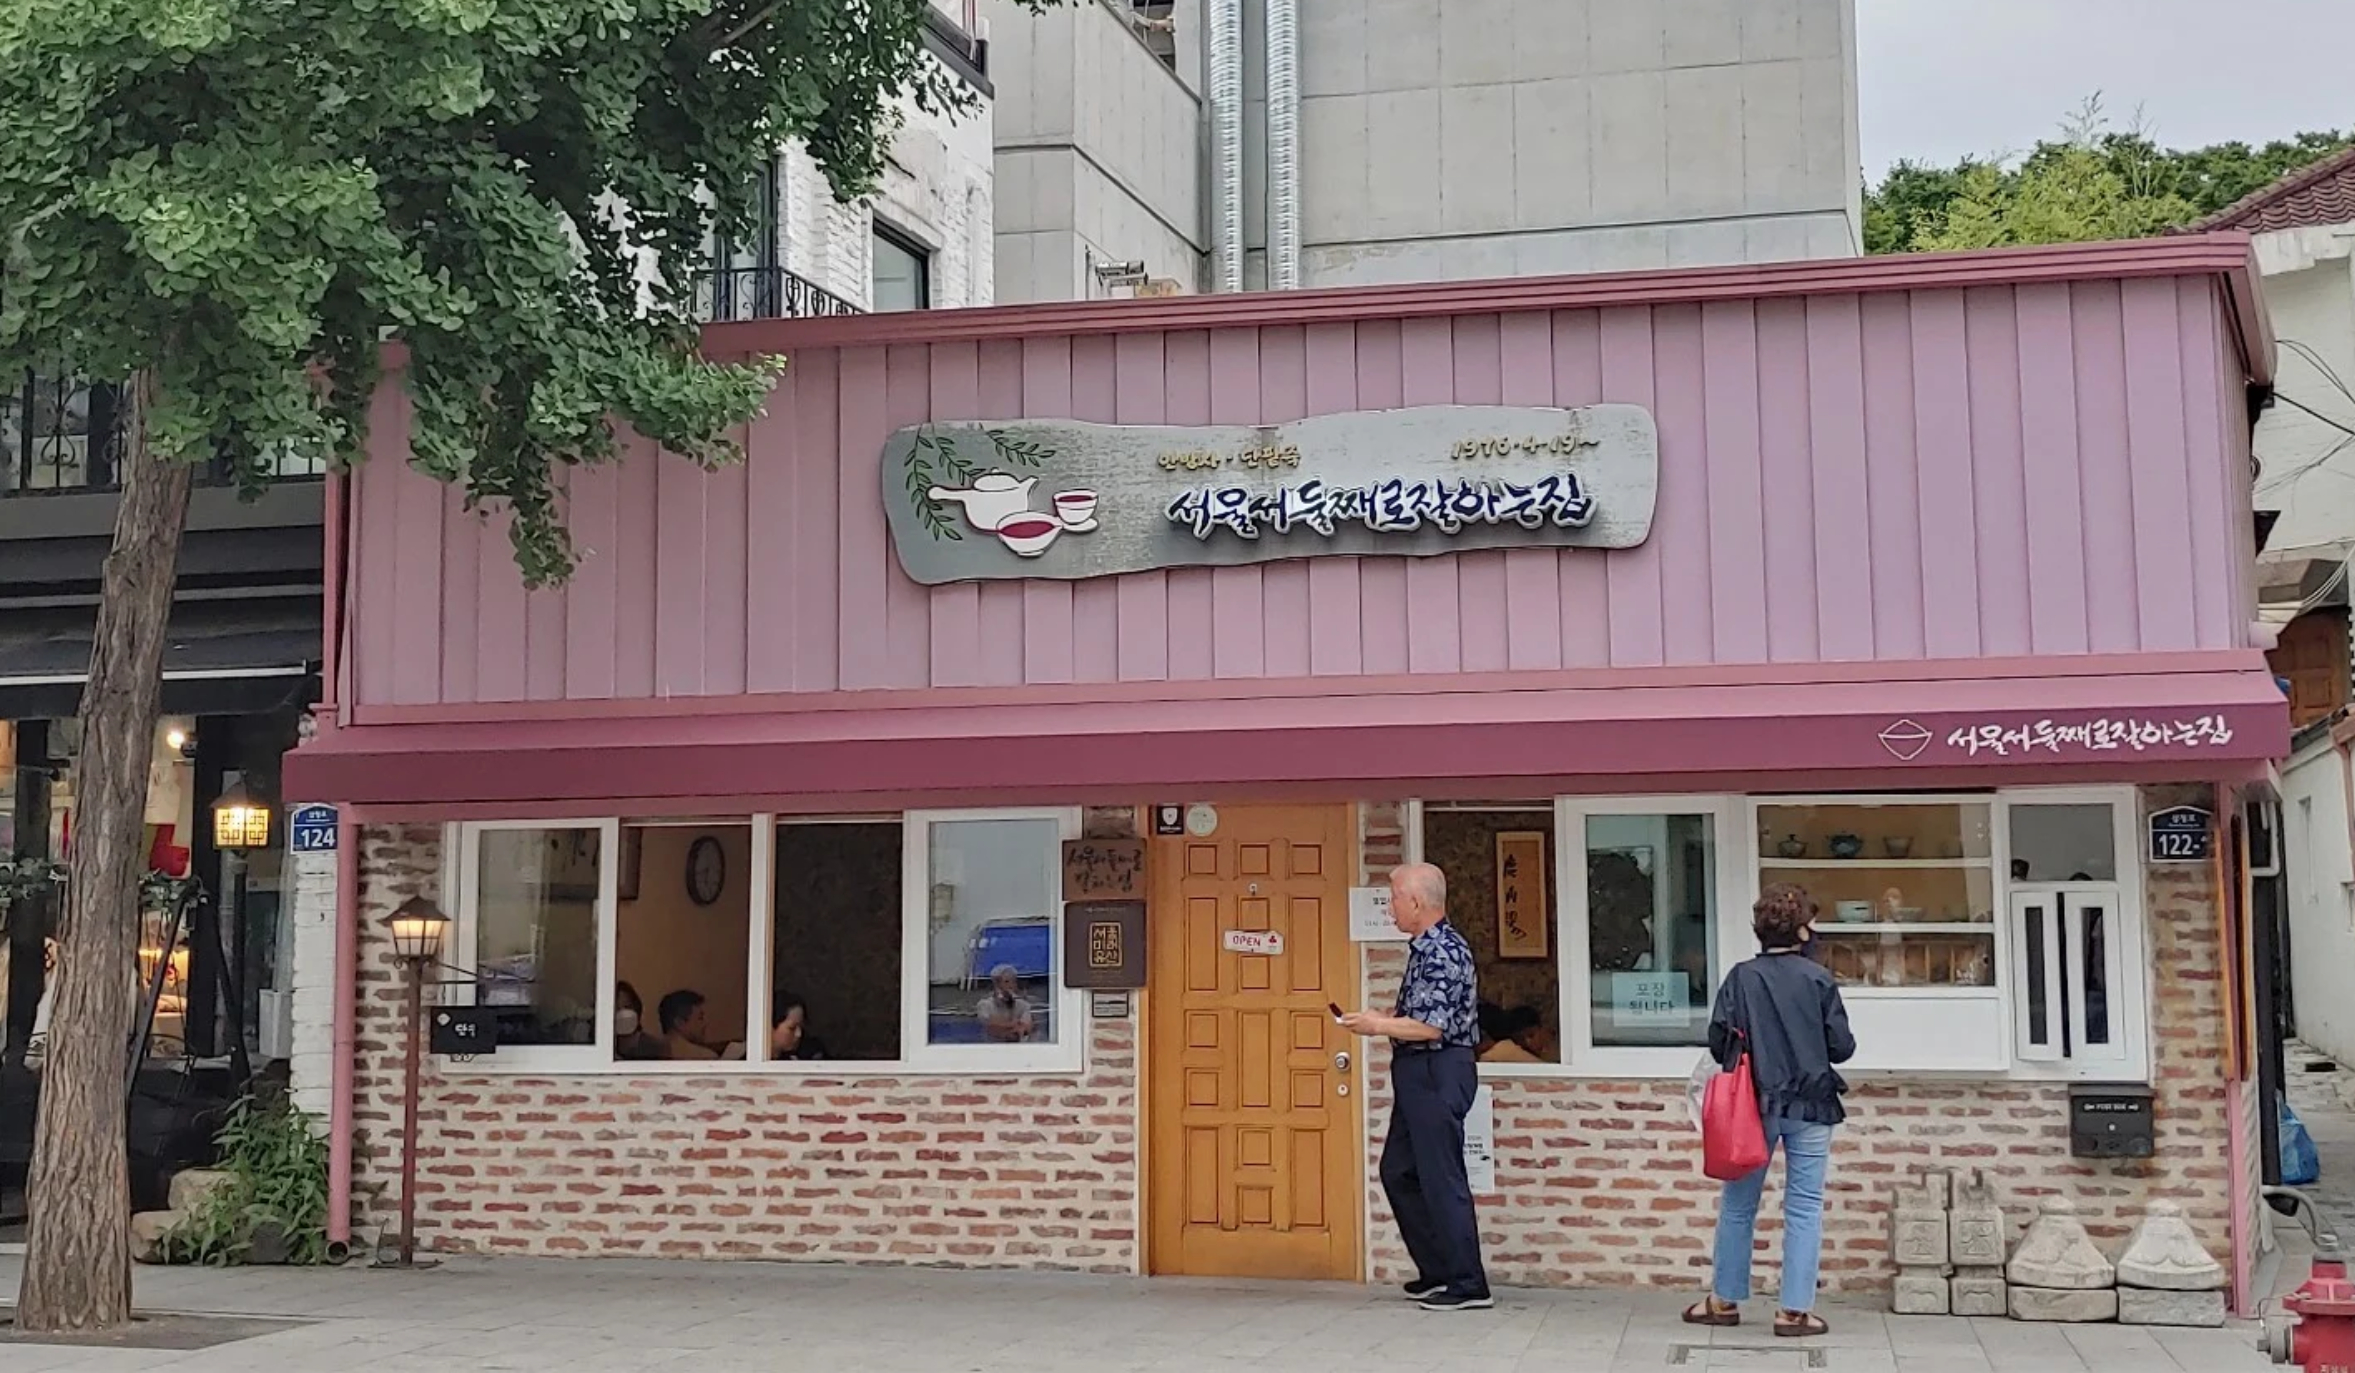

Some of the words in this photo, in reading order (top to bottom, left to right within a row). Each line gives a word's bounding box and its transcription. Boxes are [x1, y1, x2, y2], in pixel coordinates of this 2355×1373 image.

[300, 827, 336, 848] 124
[2159, 833, 2207, 856] 122-
[1232, 935, 1261, 947] OPEN
